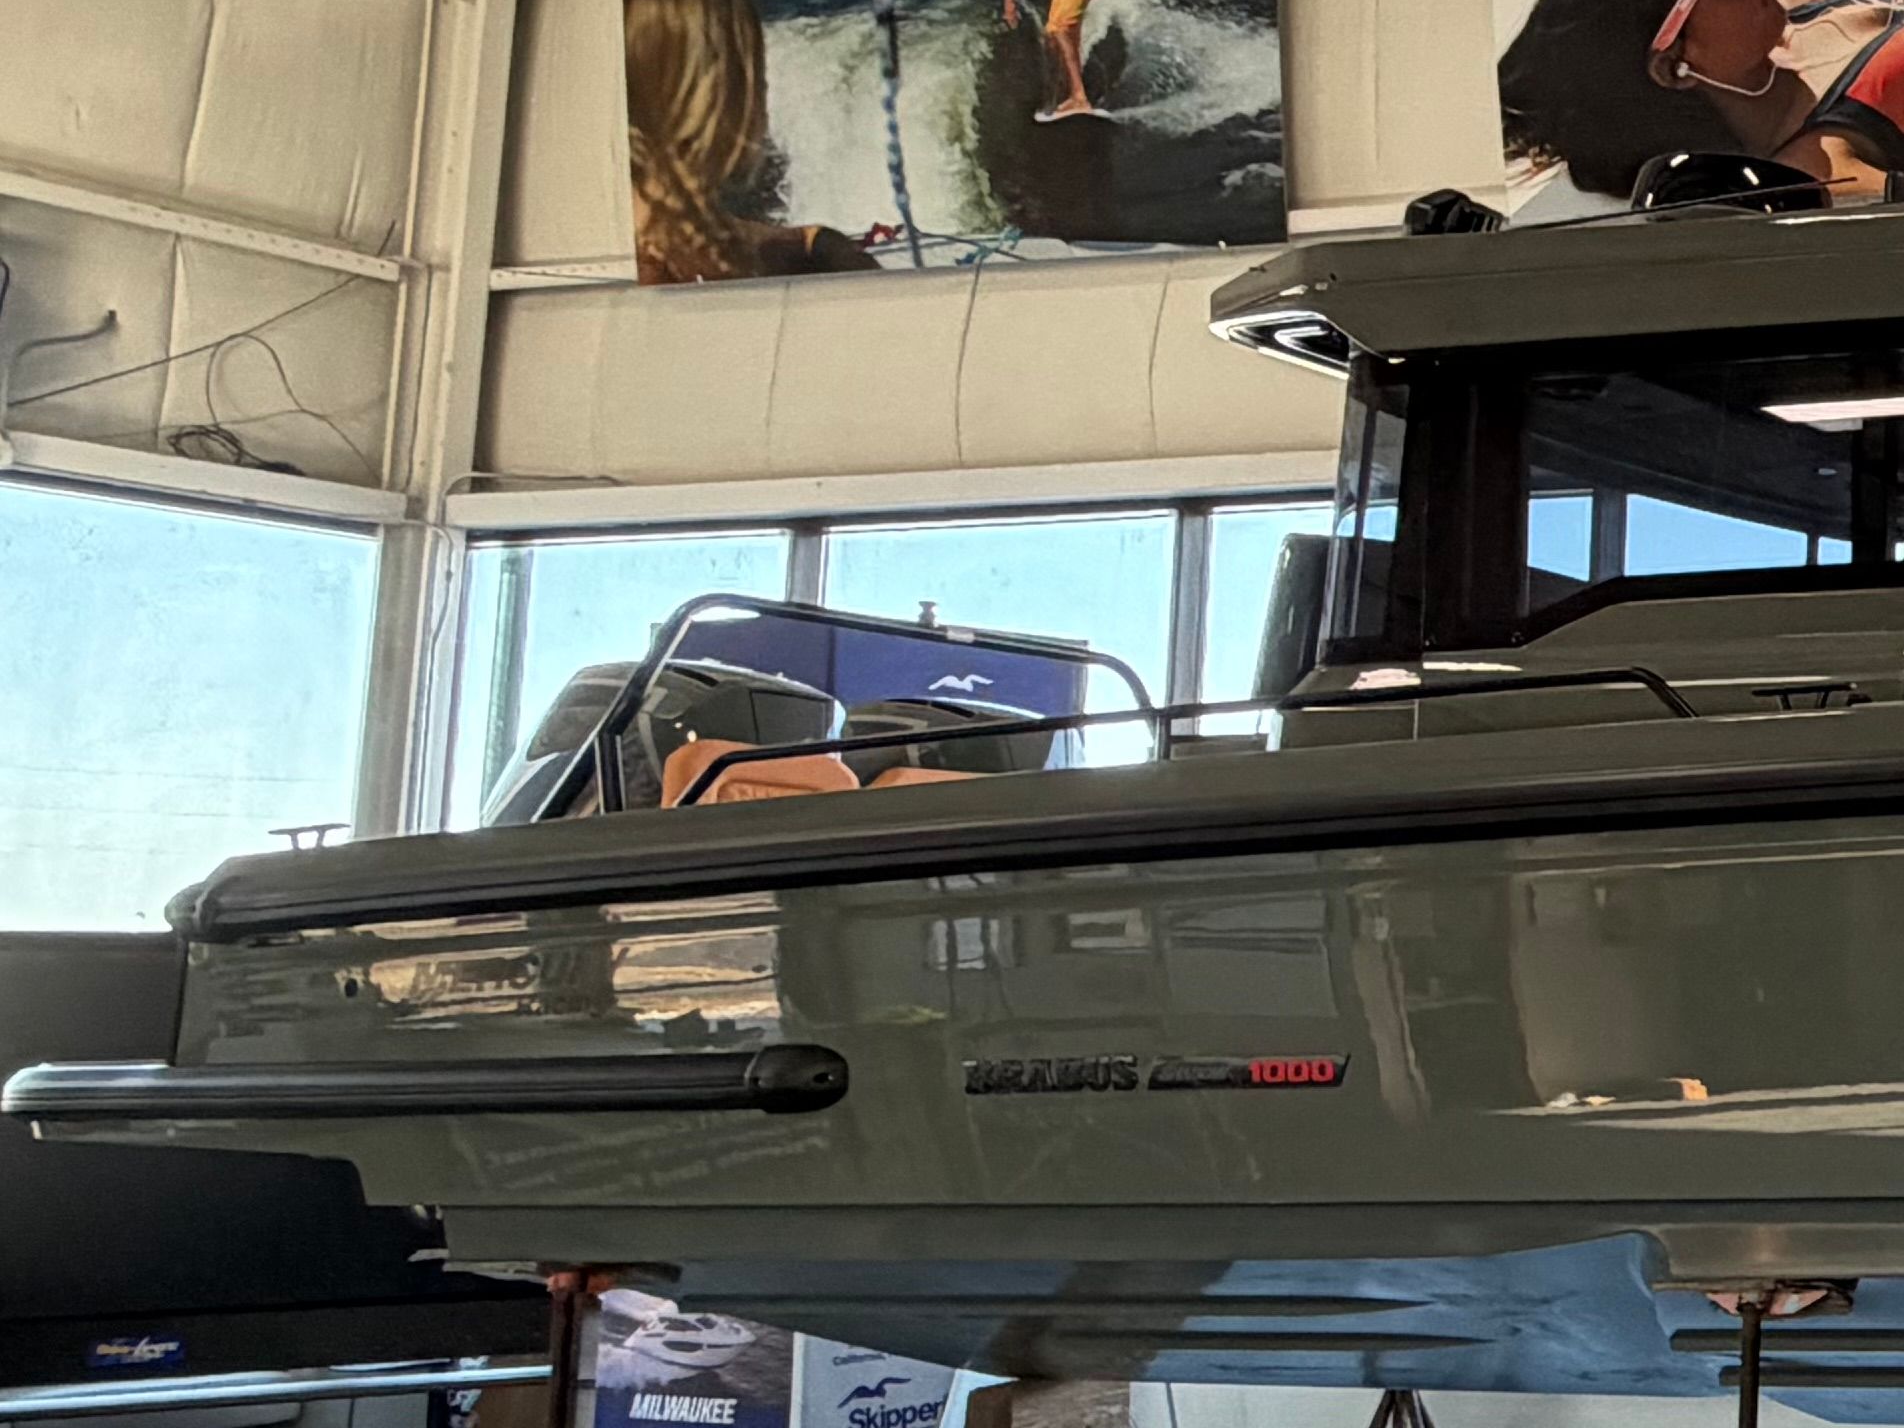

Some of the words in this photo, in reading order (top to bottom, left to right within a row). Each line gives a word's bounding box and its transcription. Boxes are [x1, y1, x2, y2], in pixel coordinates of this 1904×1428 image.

[963, 1055, 1139, 1094] BRABUS
[1248, 1058, 1336, 1083] 1000
[629, 1393, 738, 1424] MILWAUKEE
